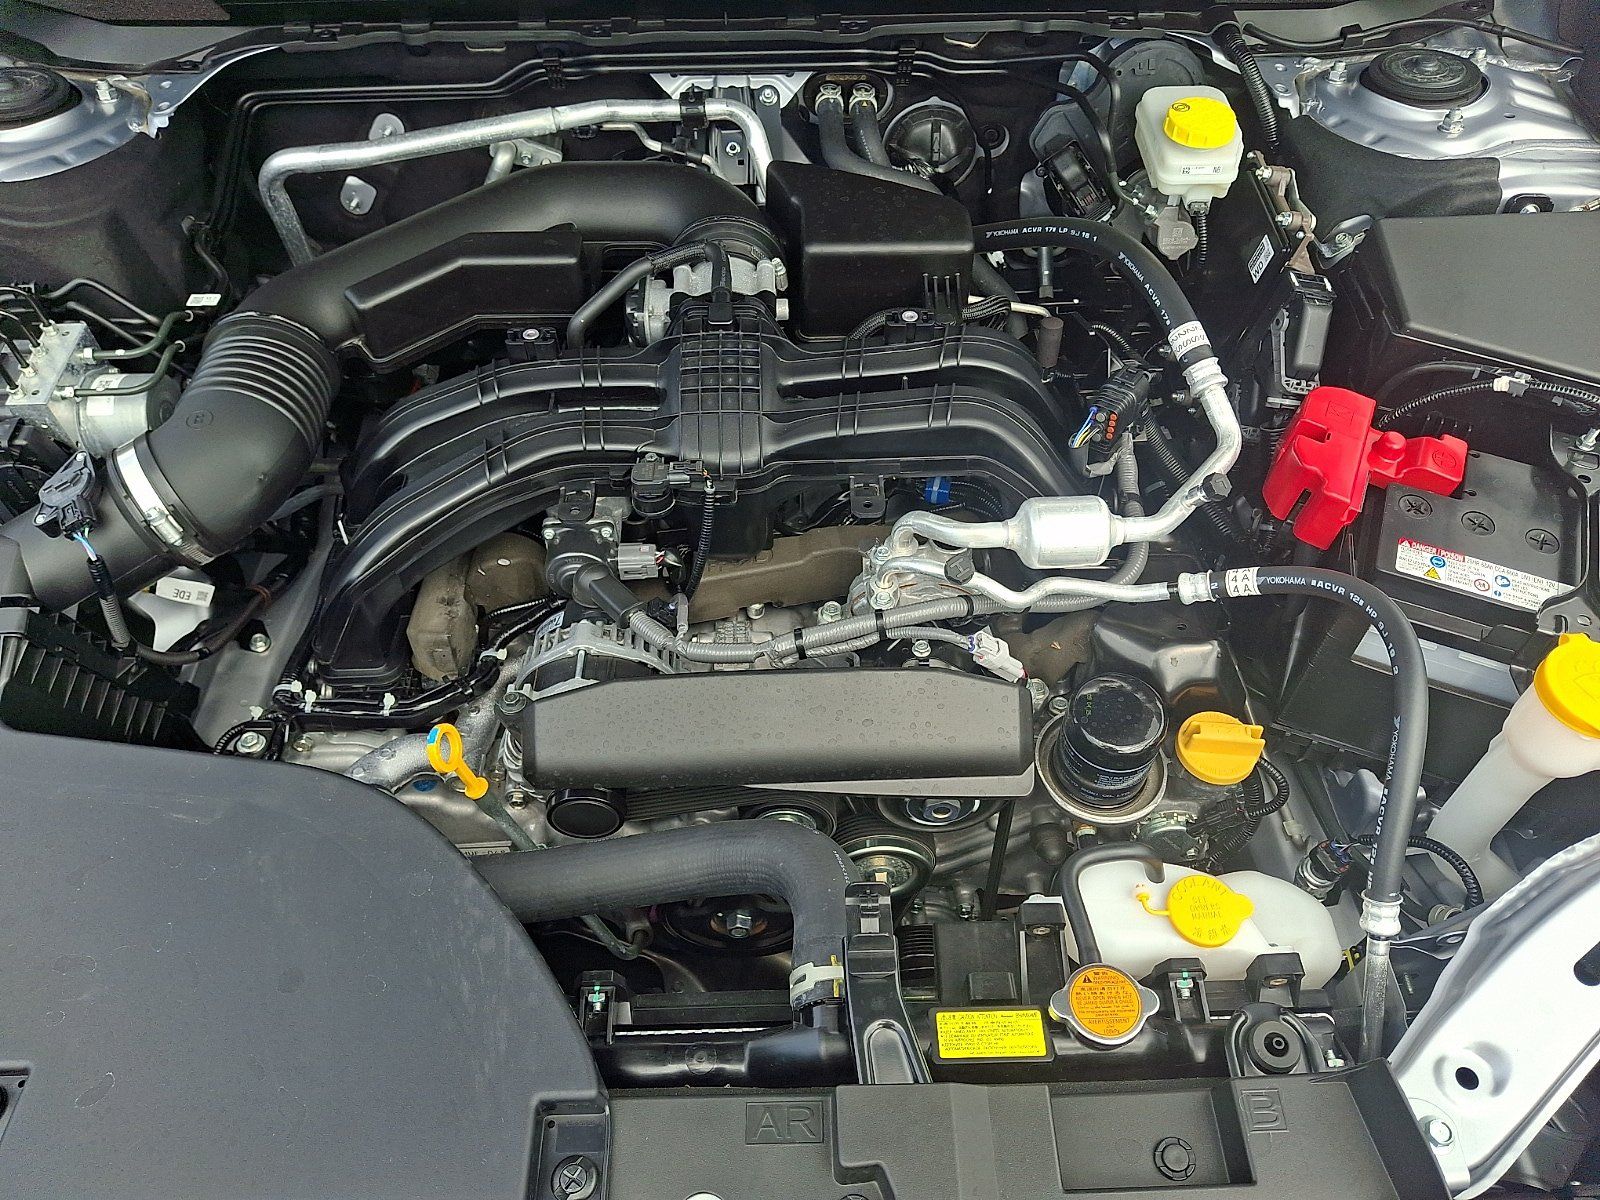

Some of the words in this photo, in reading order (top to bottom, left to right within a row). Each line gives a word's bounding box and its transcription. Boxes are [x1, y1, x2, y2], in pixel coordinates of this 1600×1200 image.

[1022, 226, 1042, 234] ACVR
[1144, 283, 1161, 307] ACVR
[1411, 542, 1437, 556] DANGER
[1440, 549, 1465, 563] POISON
[172, 588, 191, 600] EDE
[1266, 577, 1306, 585] YOKOHAMA
[1365, 605, 1377, 619] HP
[1387, 729, 1400, 780] YOKOHAMA
[751, 1105, 816, 1140] AR
